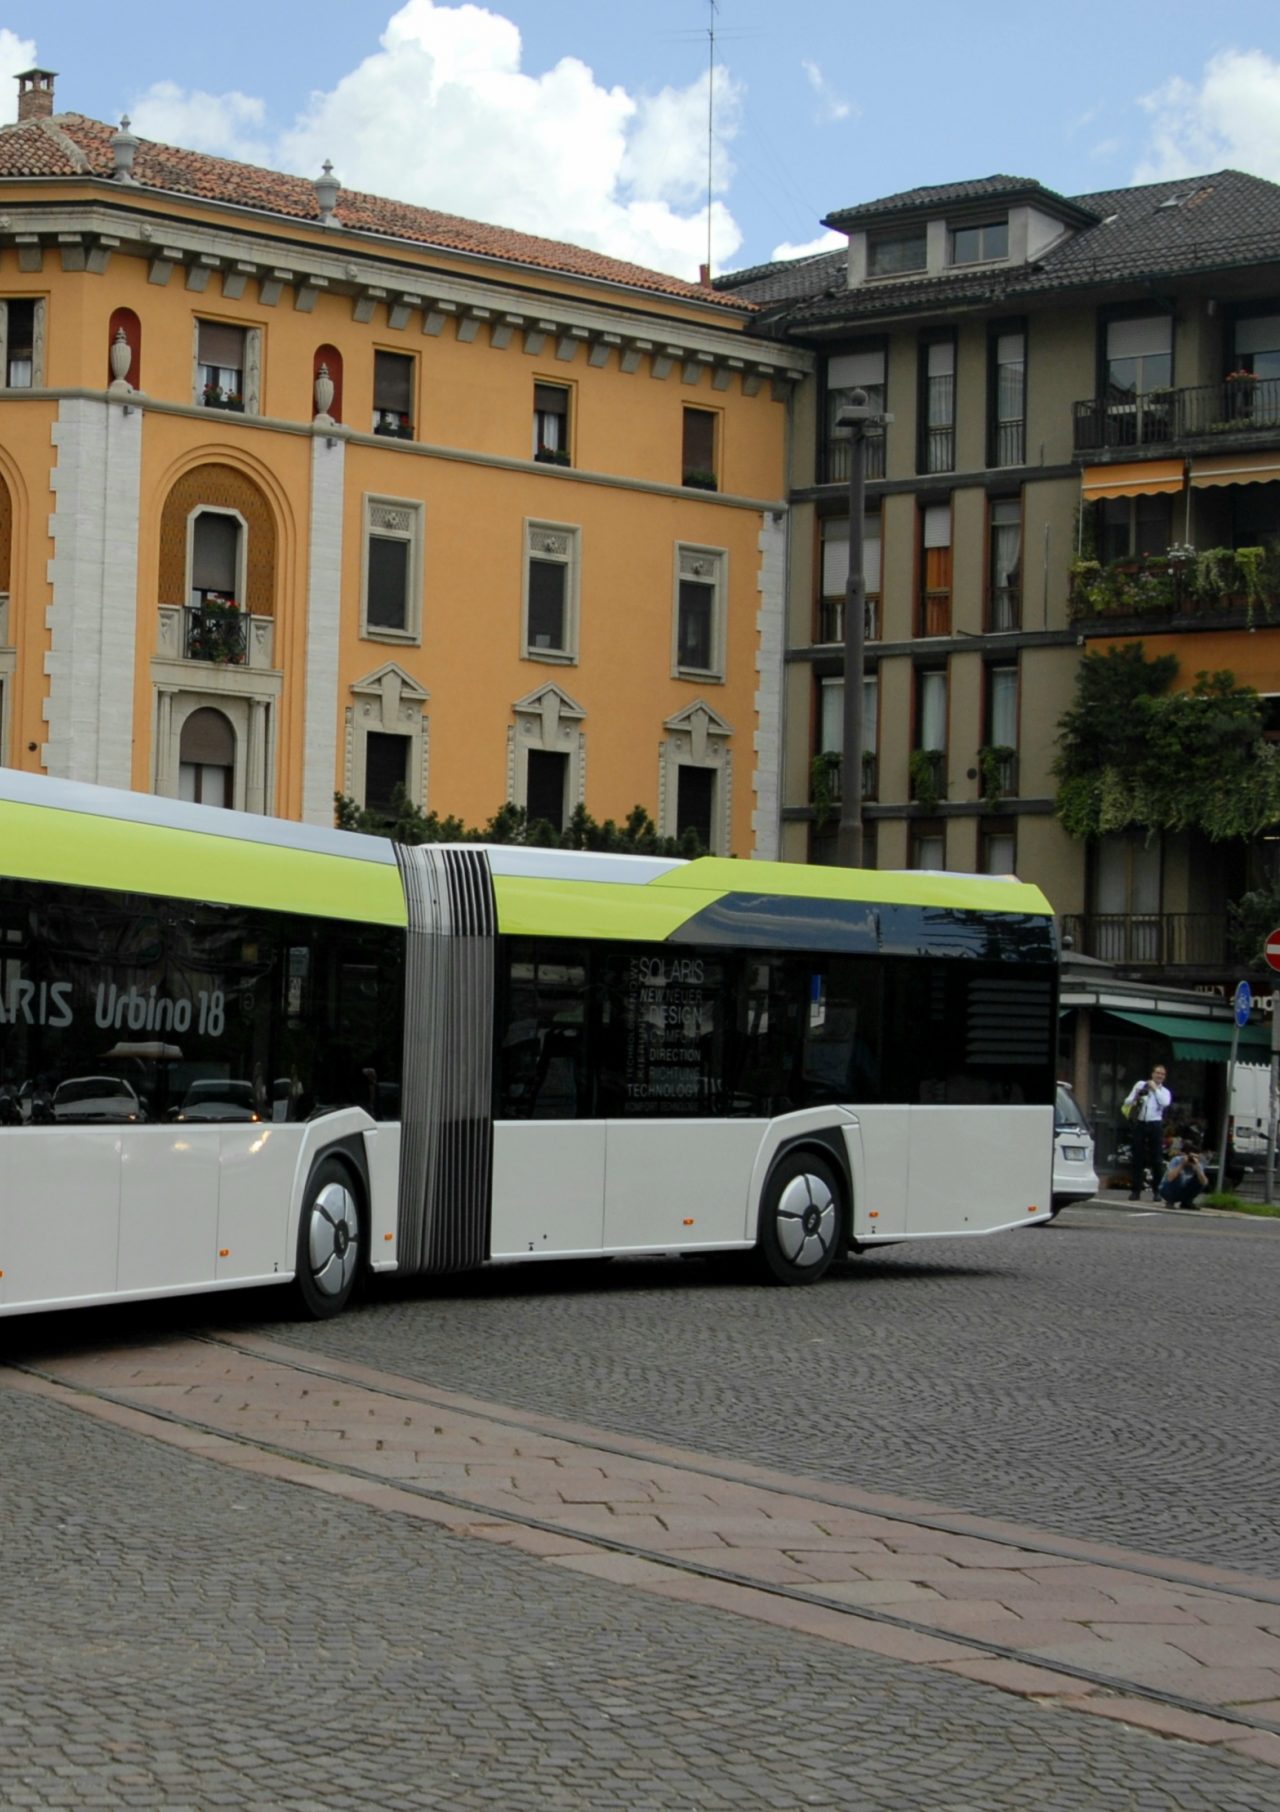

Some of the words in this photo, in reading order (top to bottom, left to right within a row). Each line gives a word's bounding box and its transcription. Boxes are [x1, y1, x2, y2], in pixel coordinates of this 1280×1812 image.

[639, 957, 705, 984] SOLARIS
[640, 987, 665, 1003] NEW
[94, 981, 193, 1034] Urbino
[197, 990, 225, 1038] 18
[649, 1005, 704, 1025] DESIGN
[649, 1048, 701, 1062] DIRECTION
[627, 1082, 701, 1098] TECHNOLOGY
